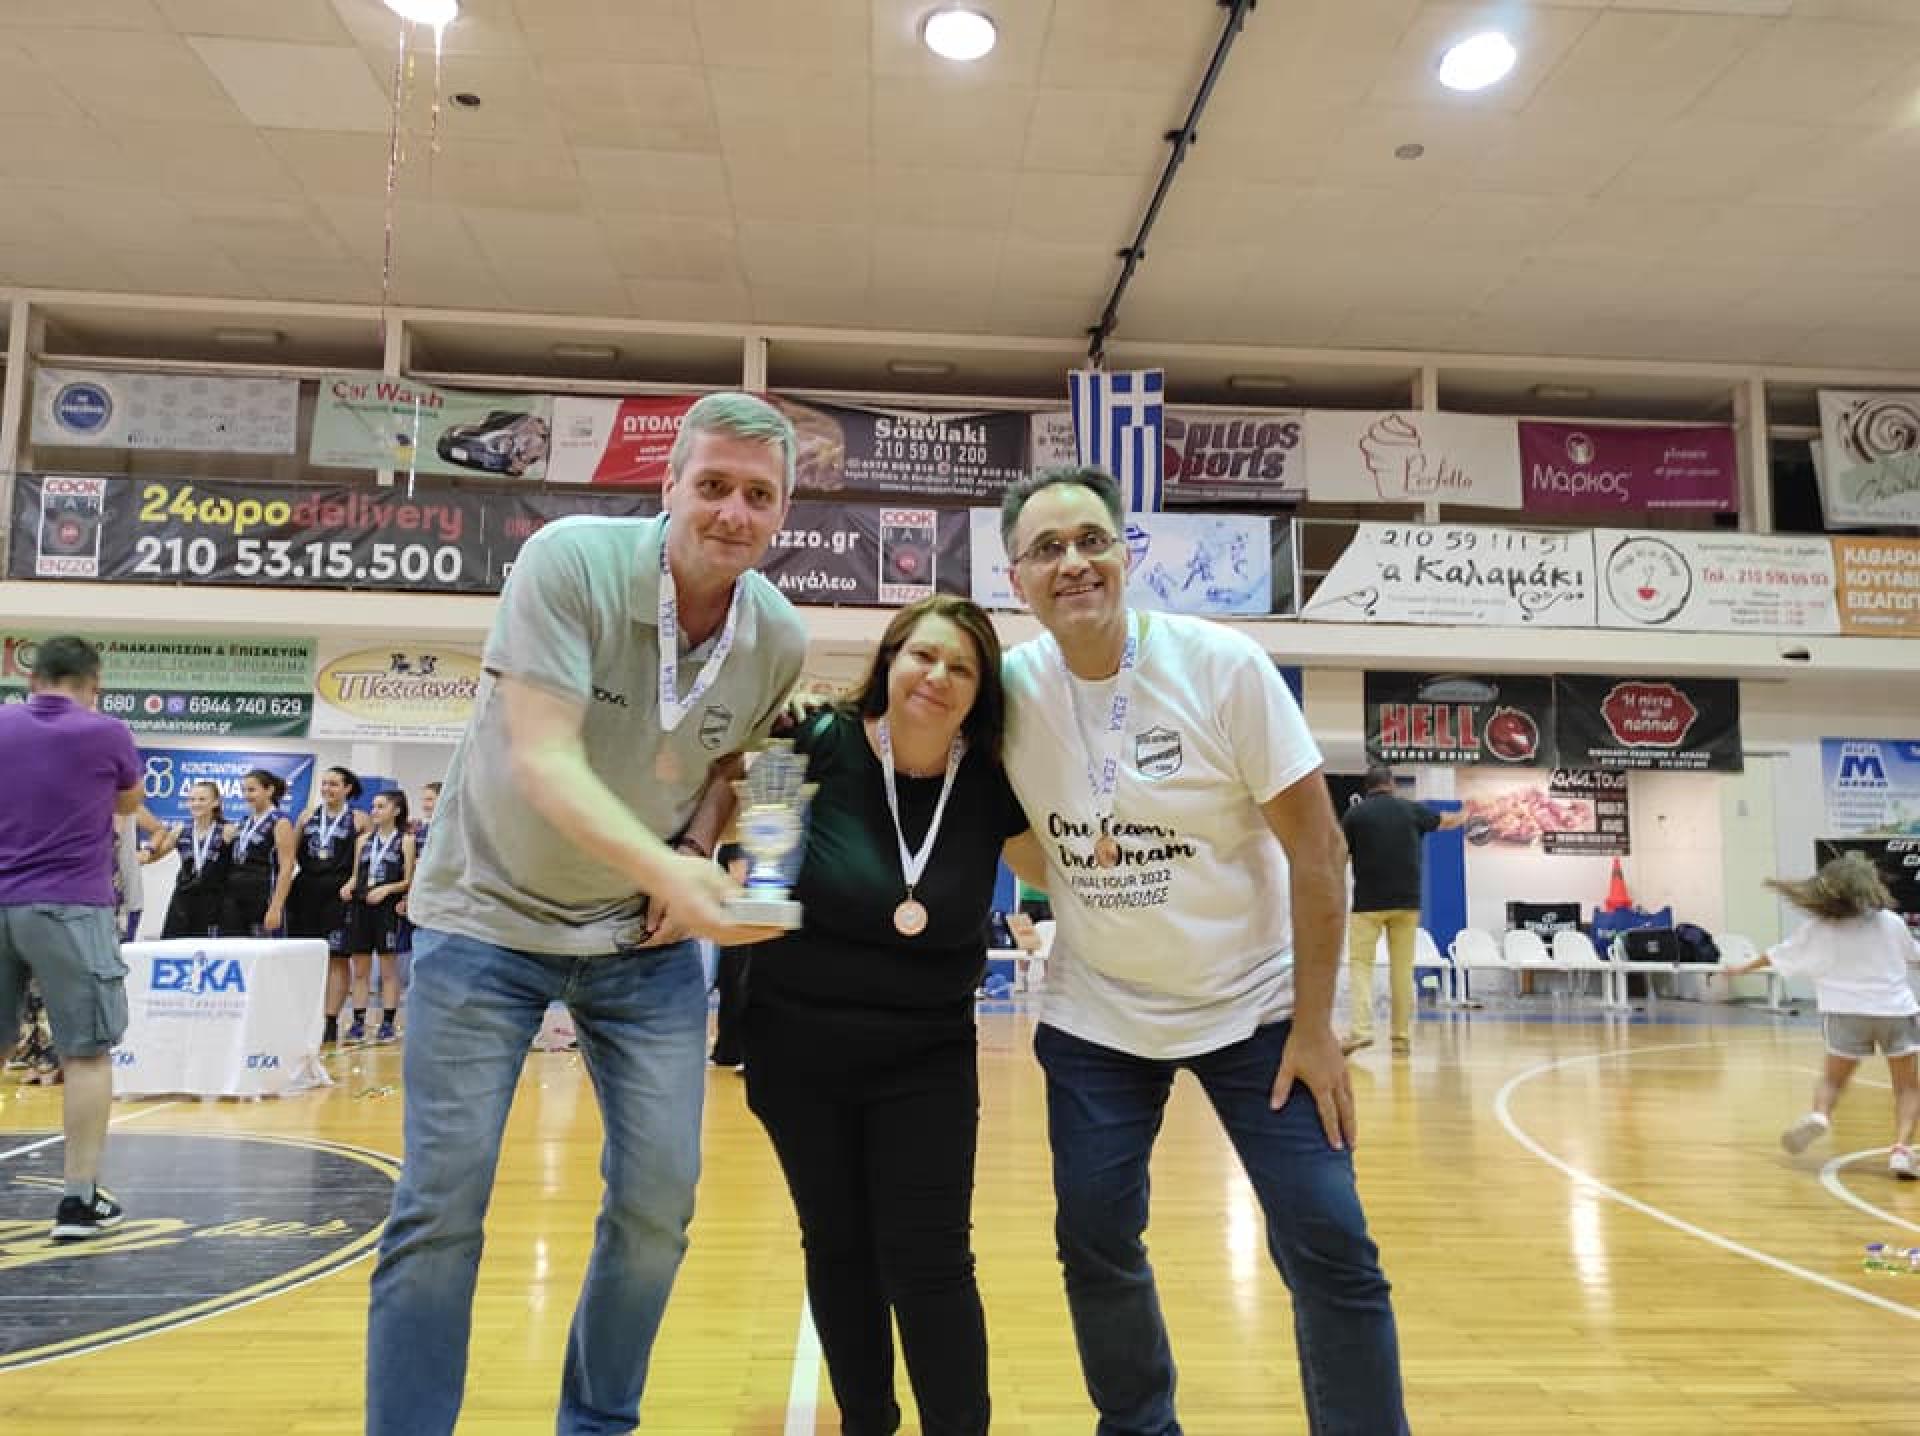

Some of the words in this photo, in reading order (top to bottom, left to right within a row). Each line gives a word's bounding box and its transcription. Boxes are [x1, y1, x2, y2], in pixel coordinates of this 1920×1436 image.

[333, 381, 368, 400] Car
[377, 382, 445, 409] Wash
[874, 418, 987, 444] Souvlaki
[874, 440, 904, 460] 210
[908, 441, 929, 462] 59
[932, 444, 951, 463] 01
[958, 445, 988, 466] 200
[46, 478, 100, 493] COOK
[882, 510, 932, 525] COOK
[134, 535, 217, 576] 210
[233, 538, 463, 582] 53.15.500
[1843, 545, 1920, 566] ΚΑΘΑΡΟ
[777, 570, 857, 592] Αιγάλεω
[1414, 553, 1584, 599] Καλαμάκι
[102, 693, 136, 712] 680
[188, 695, 231, 715] 6944
[235, 697, 266, 715] 740
[270, 698, 302, 717] 629
[128, 717, 233, 736] roanakainiseon.gr
[1379, 702, 1481, 749] HELL
[1047, 811, 1094, 839] One
[1139, 868, 1172, 885] 2022
[151, 957, 247, 993] ΕΣΚΑ
